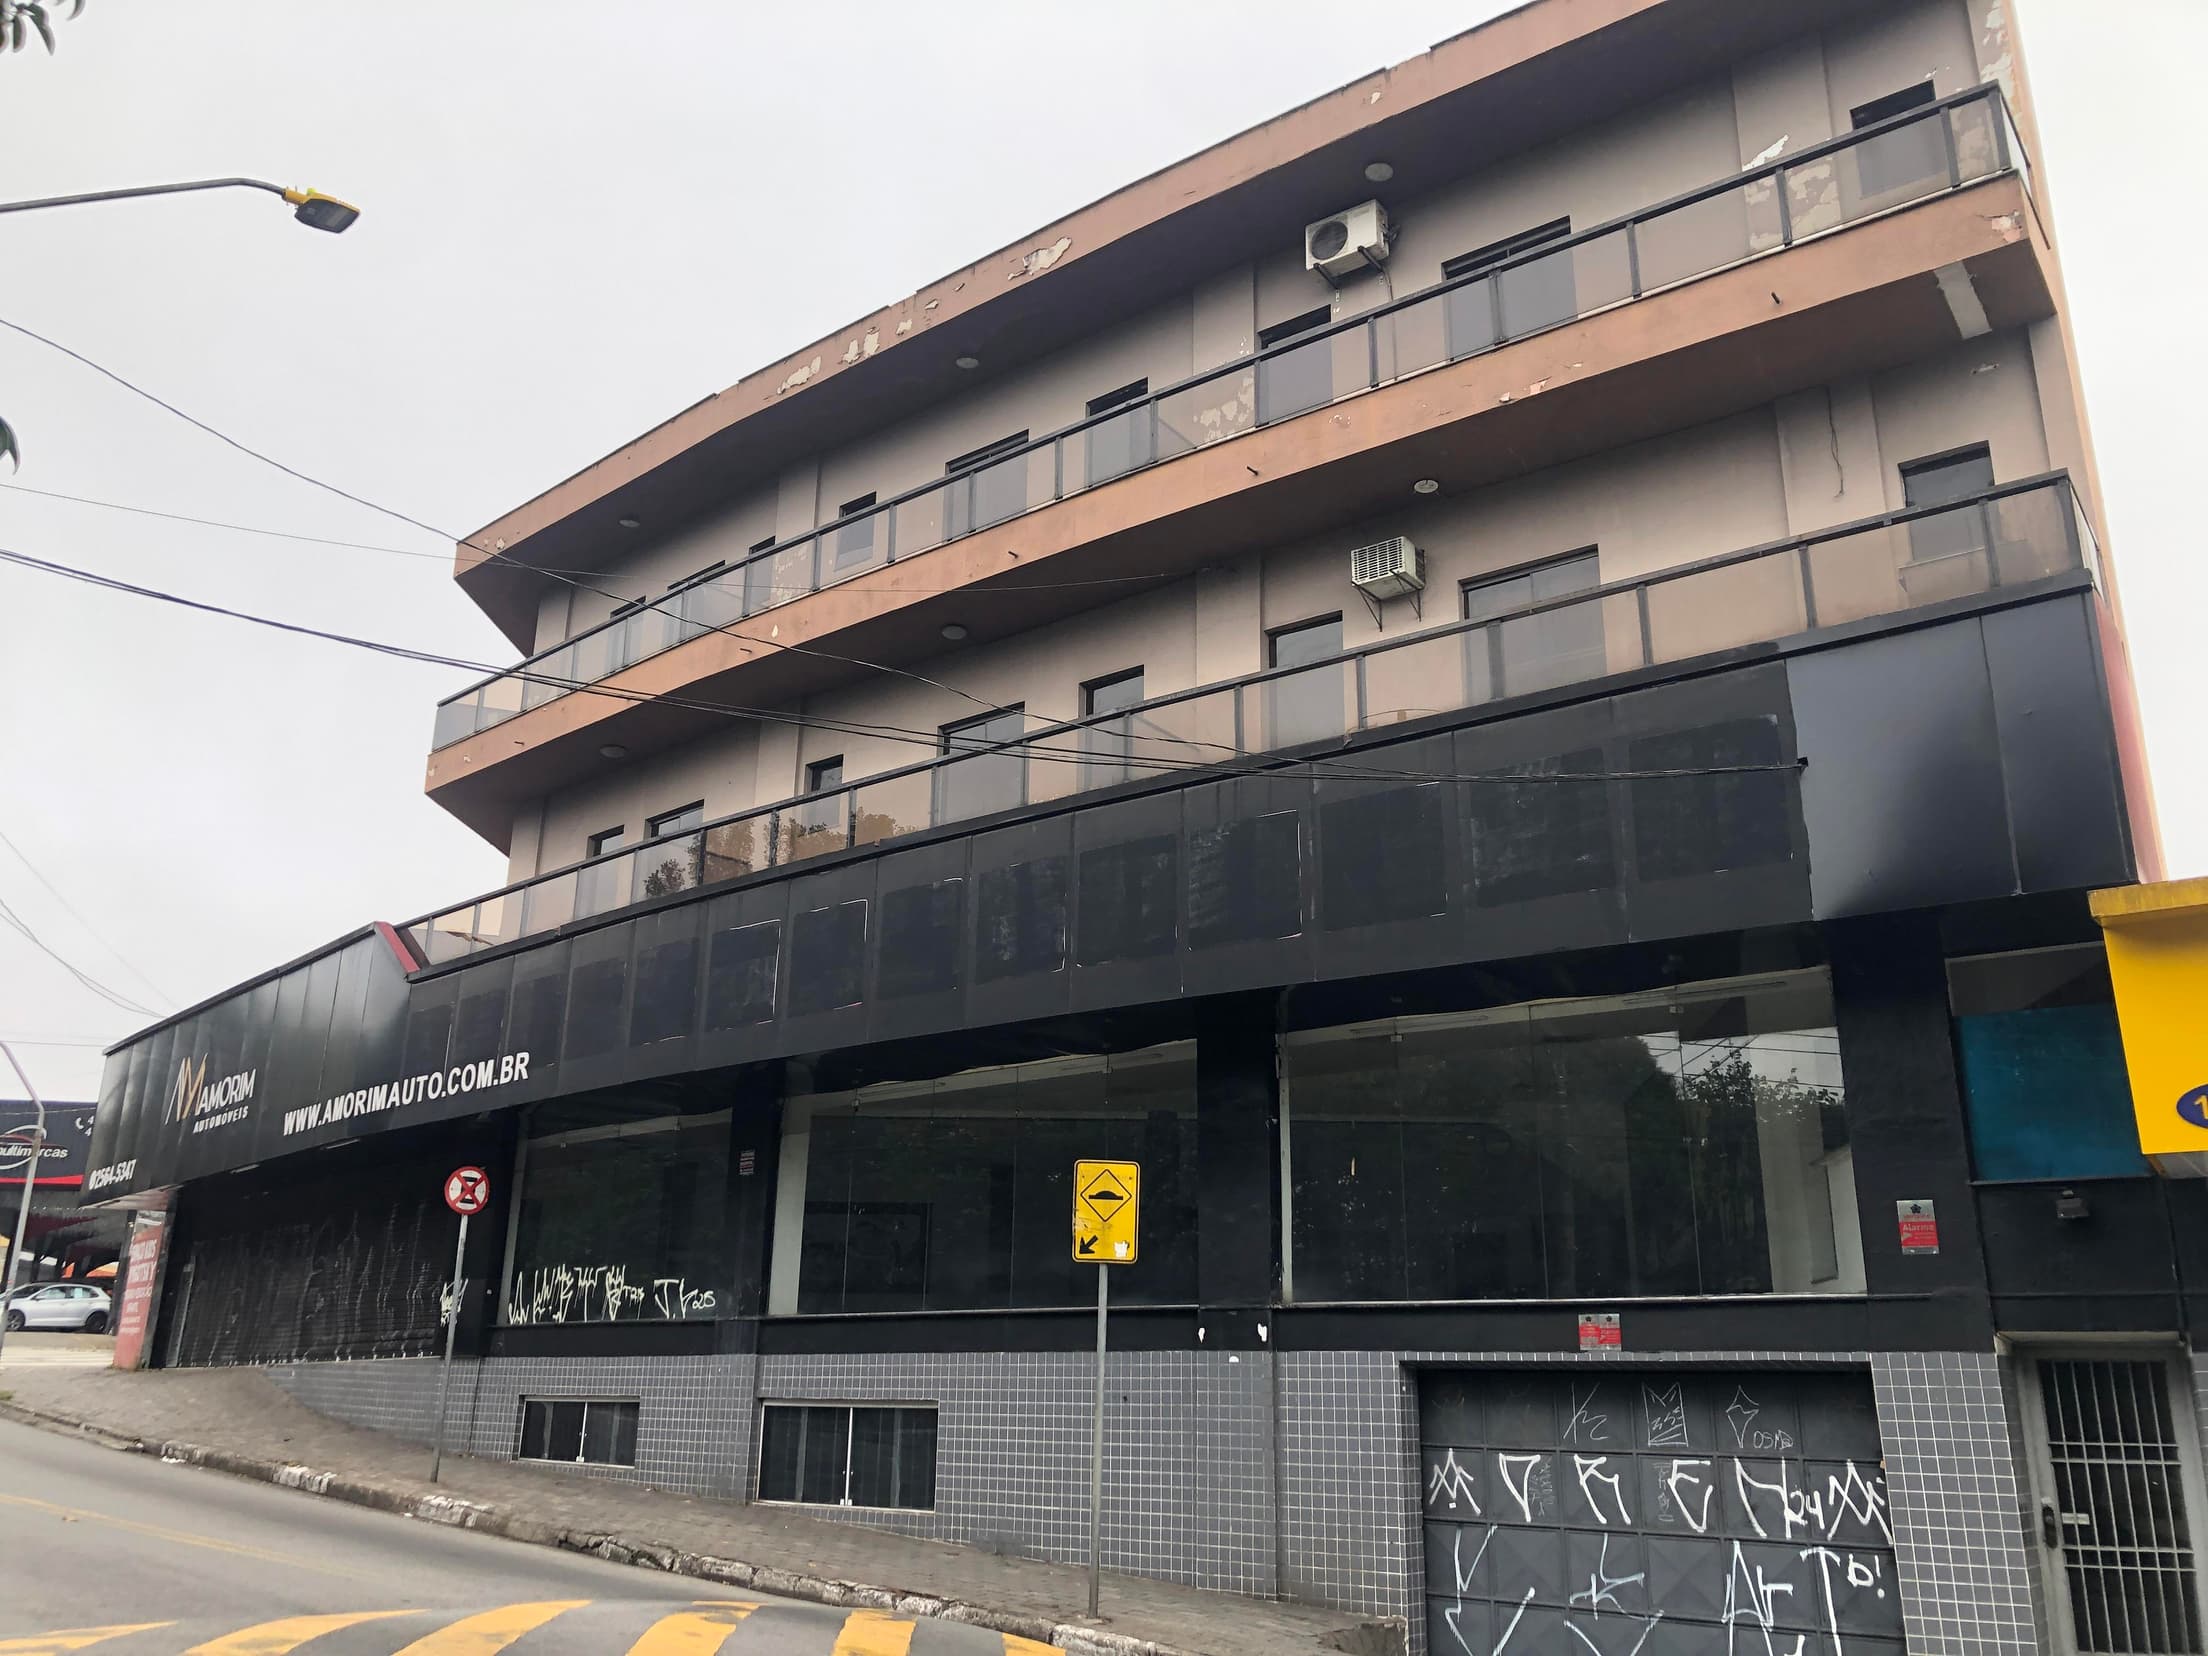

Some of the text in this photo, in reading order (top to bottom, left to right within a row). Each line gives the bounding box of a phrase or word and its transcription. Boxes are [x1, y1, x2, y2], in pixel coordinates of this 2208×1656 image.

[195, 1068, 257, 1116] AMORIM
[283, 1052, 530, 1137] WWW.AMORIMAUTO.COM.BR
[0, 1144, 69, 1159] ultimrcas
